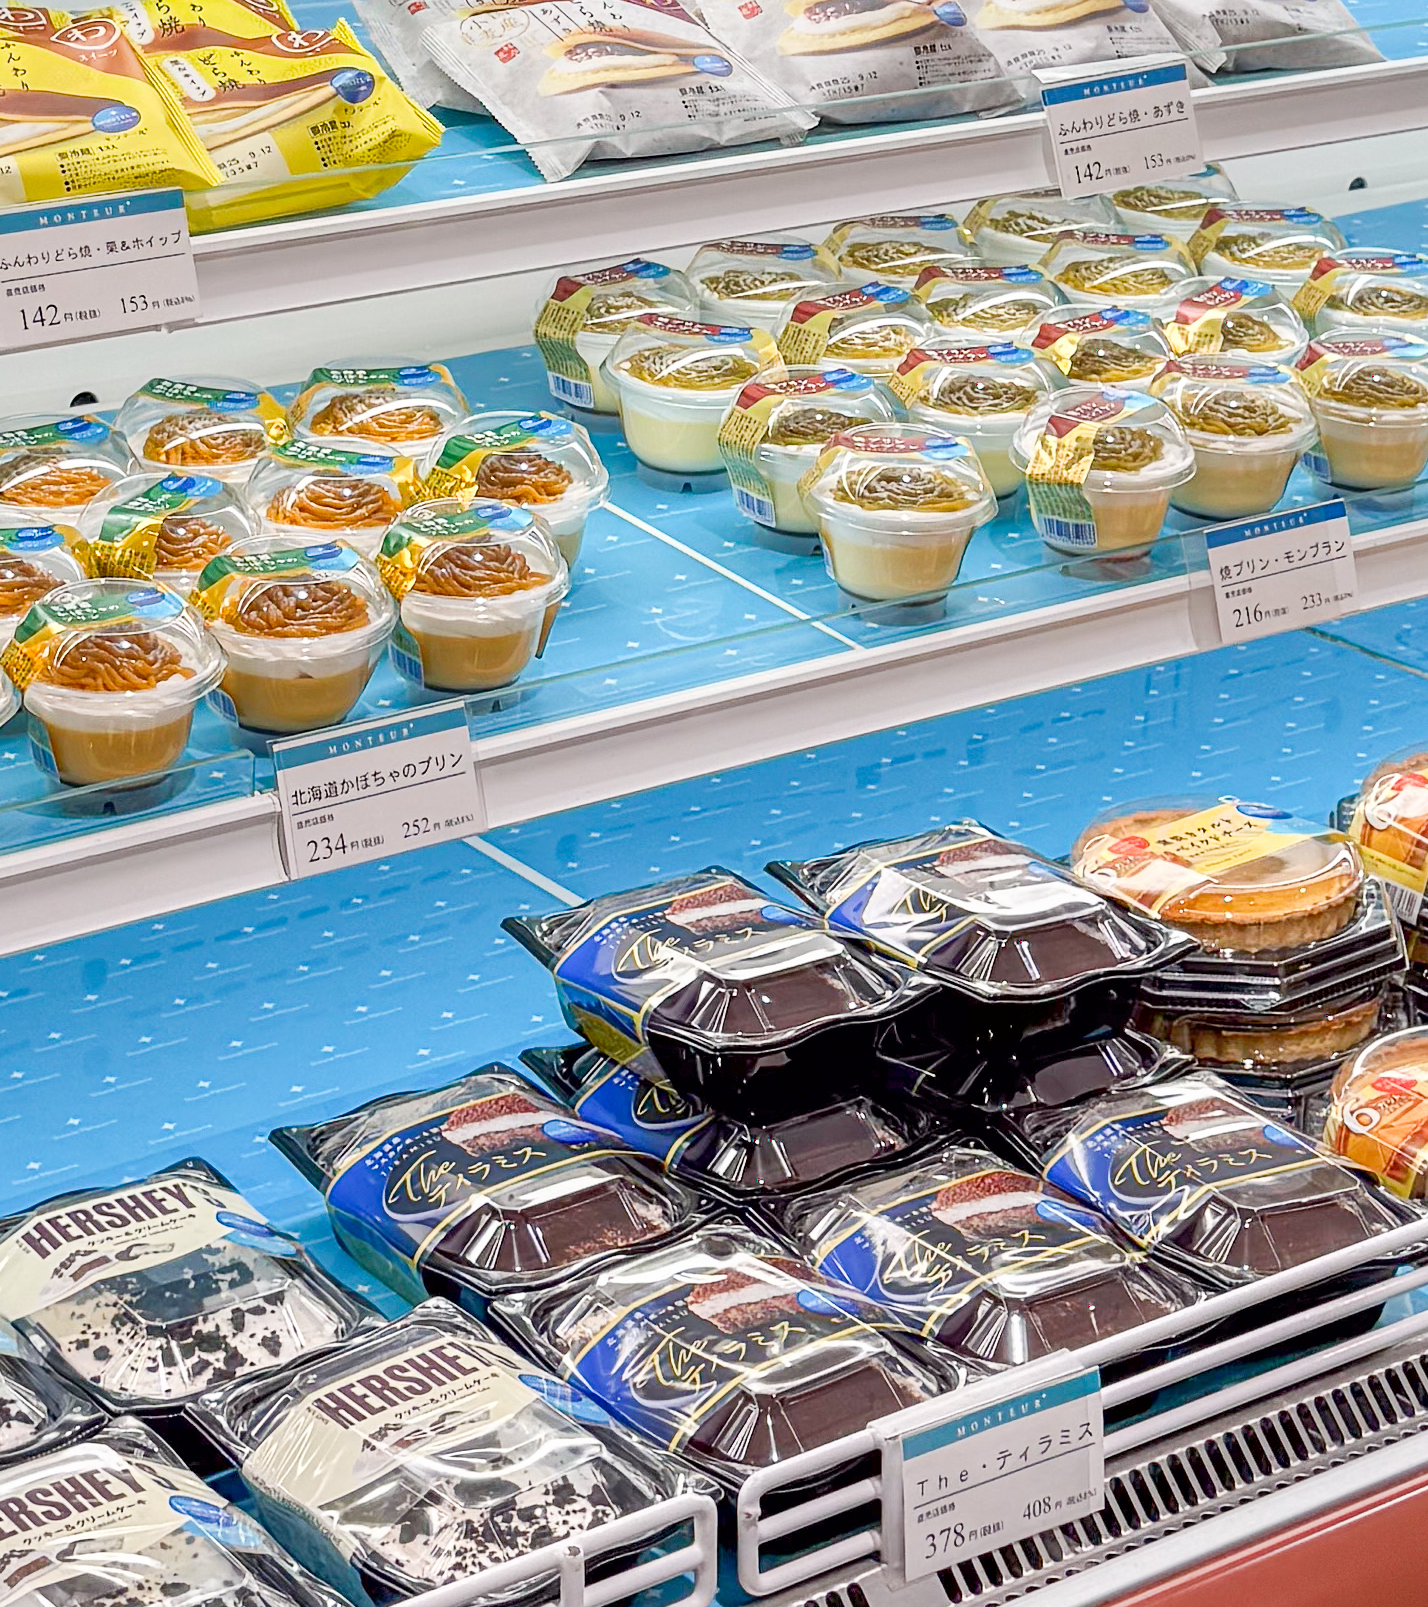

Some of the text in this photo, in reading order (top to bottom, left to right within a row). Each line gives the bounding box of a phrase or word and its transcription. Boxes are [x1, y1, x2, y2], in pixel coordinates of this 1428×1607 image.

[0, 40, 31, 92] ふんわり
[1058, 100, 1186, 137] ふんわりどら焼・あずき
[1074, 153, 1165, 185] 142 153
[38, 204, 127, 227] MONTEUR
[0, 230, 182, 271] ふんわりどら焼・栗&ホイップ
[1219, 539, 1345, 582] 焼プリン・モンブラン
[1232, 591, 1323, 628] 216 233
[328, 727, 409, 755] MONTEUR
[291, 752, 464, 807] 北海道かぼちゃのプリン
[388, 1145, 458, 1206] The
[21, 1182, 227, 1261] HERSHEY'S
[956, 1397, 1043, 1438] MONTEUR
[916, 1421, 1095, 1497] The・ティラミス
